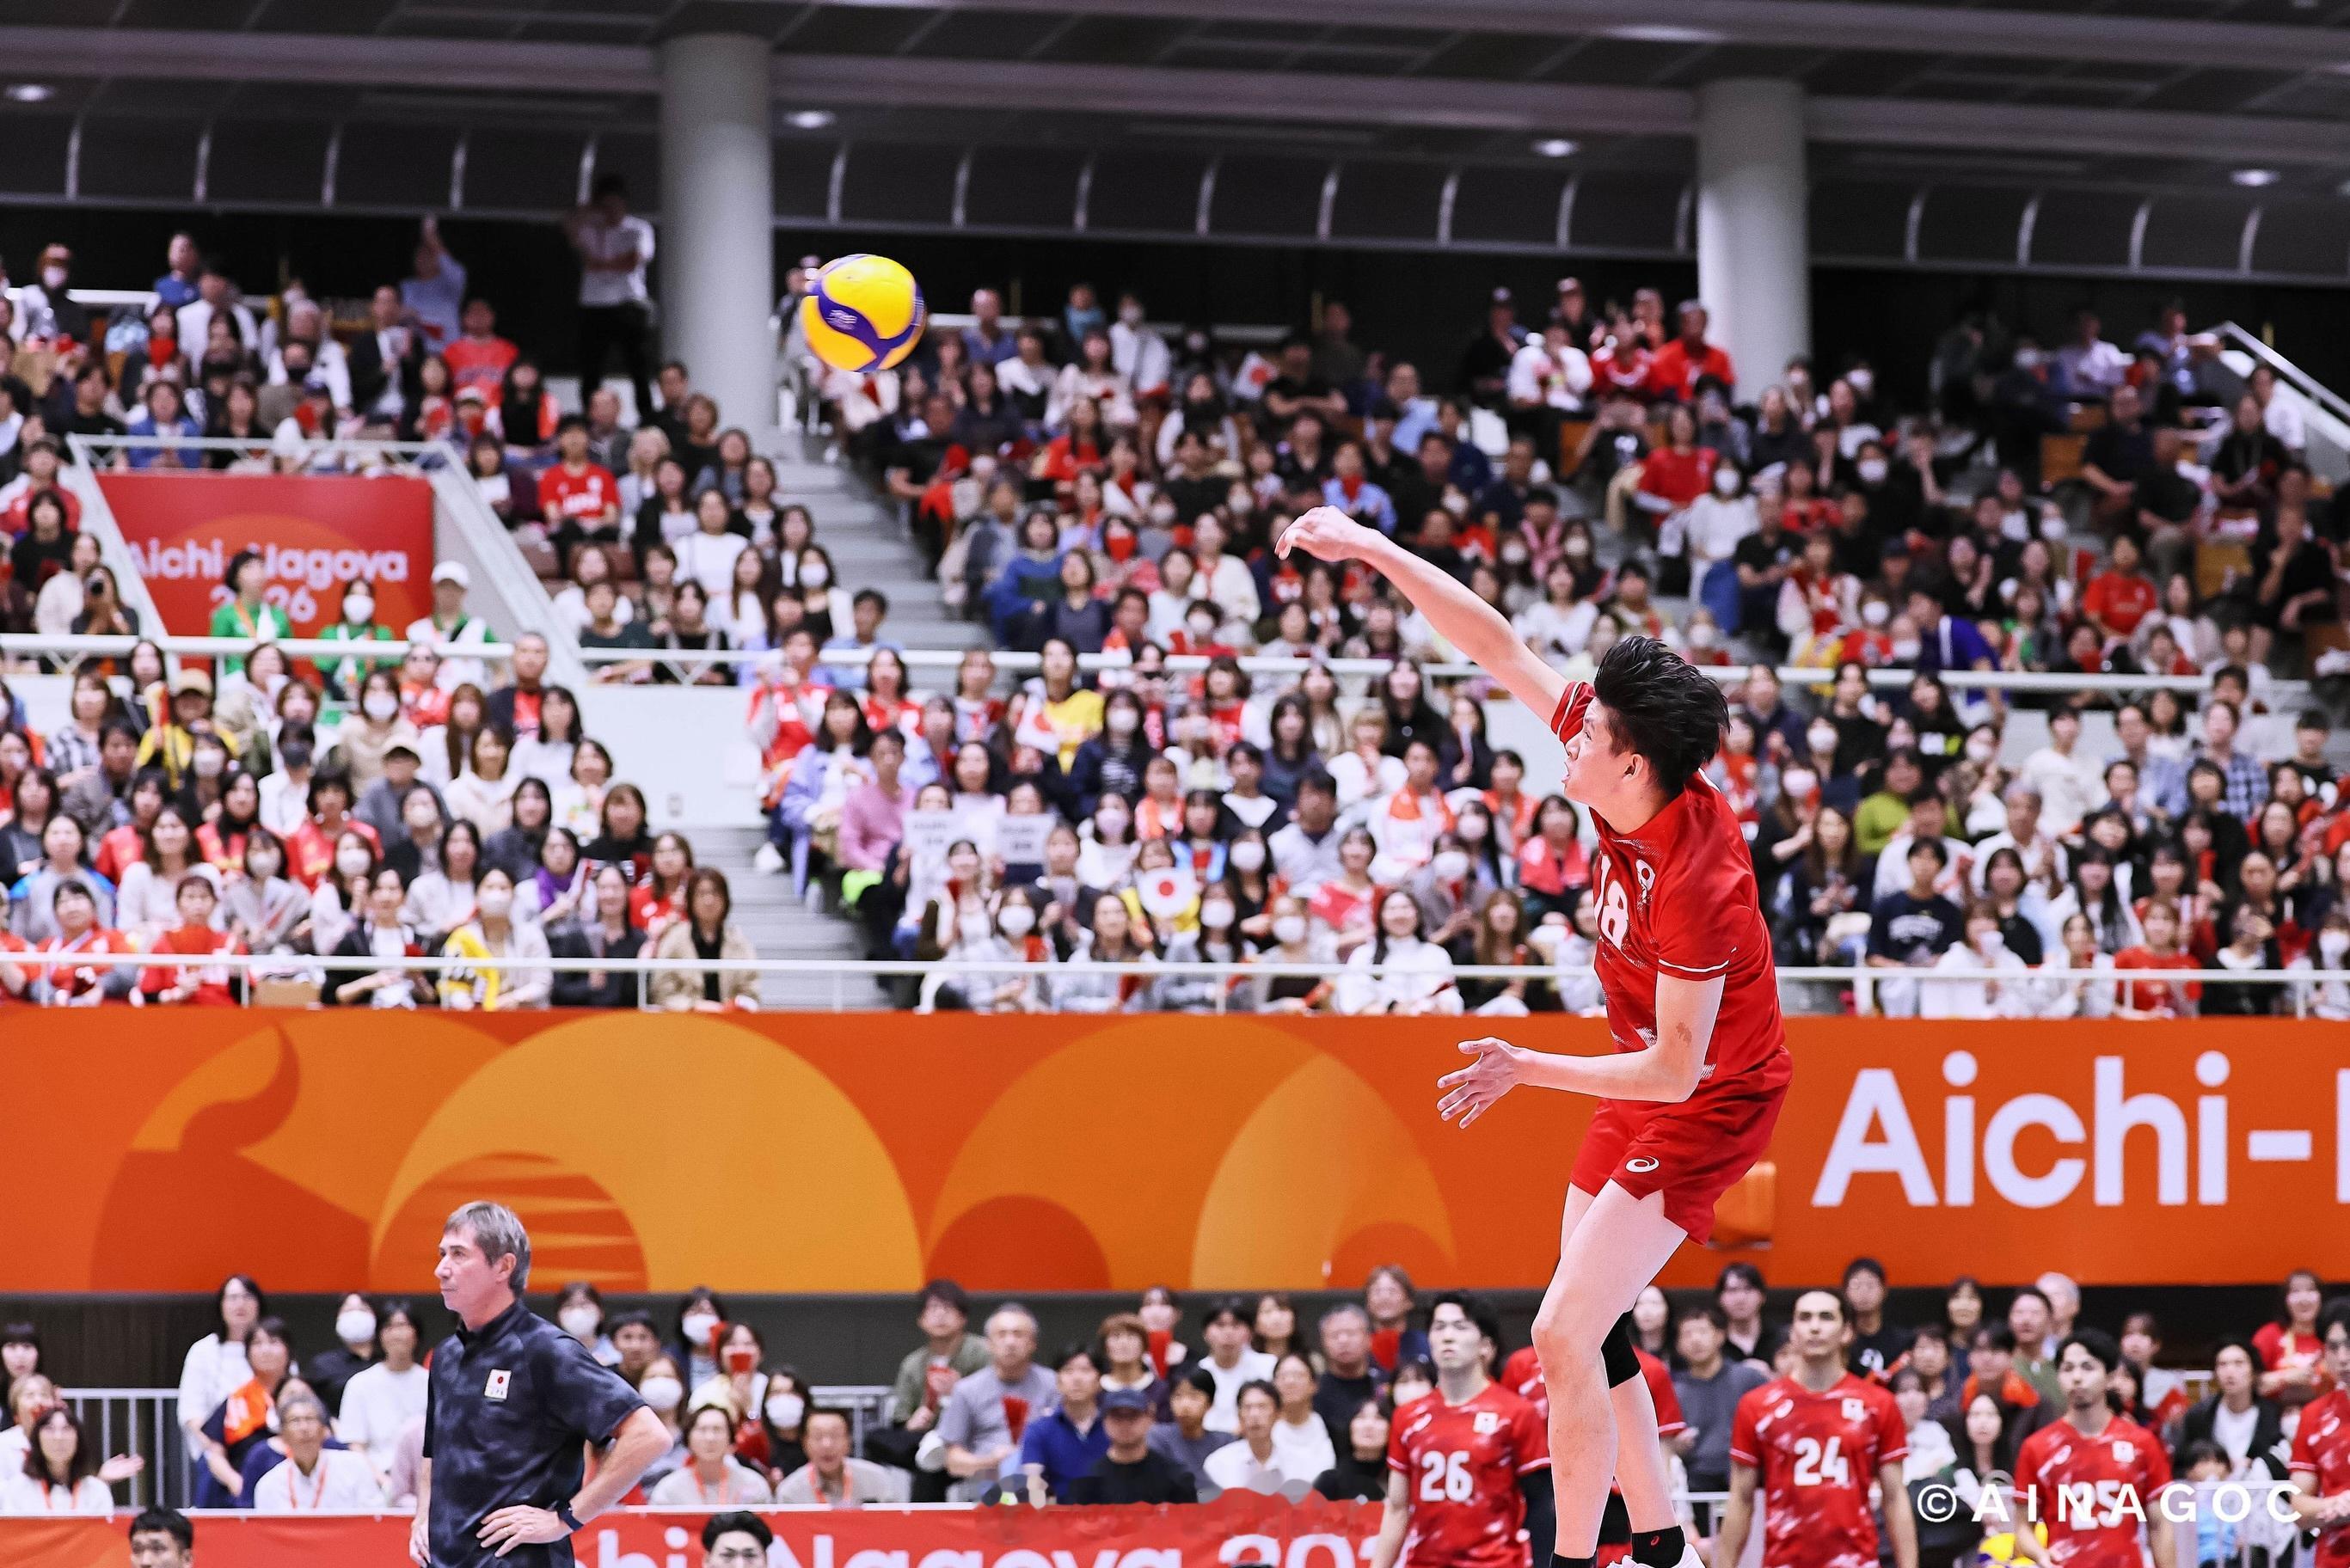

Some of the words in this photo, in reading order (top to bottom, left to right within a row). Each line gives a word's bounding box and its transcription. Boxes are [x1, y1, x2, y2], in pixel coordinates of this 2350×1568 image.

[210, 584, 317, 623] 226
[1811, 1050, 2350, 1207] Aichi-
[1420, 1450, 1473, 1503] 26
[1794, 1437, 1850, 1487] 24
